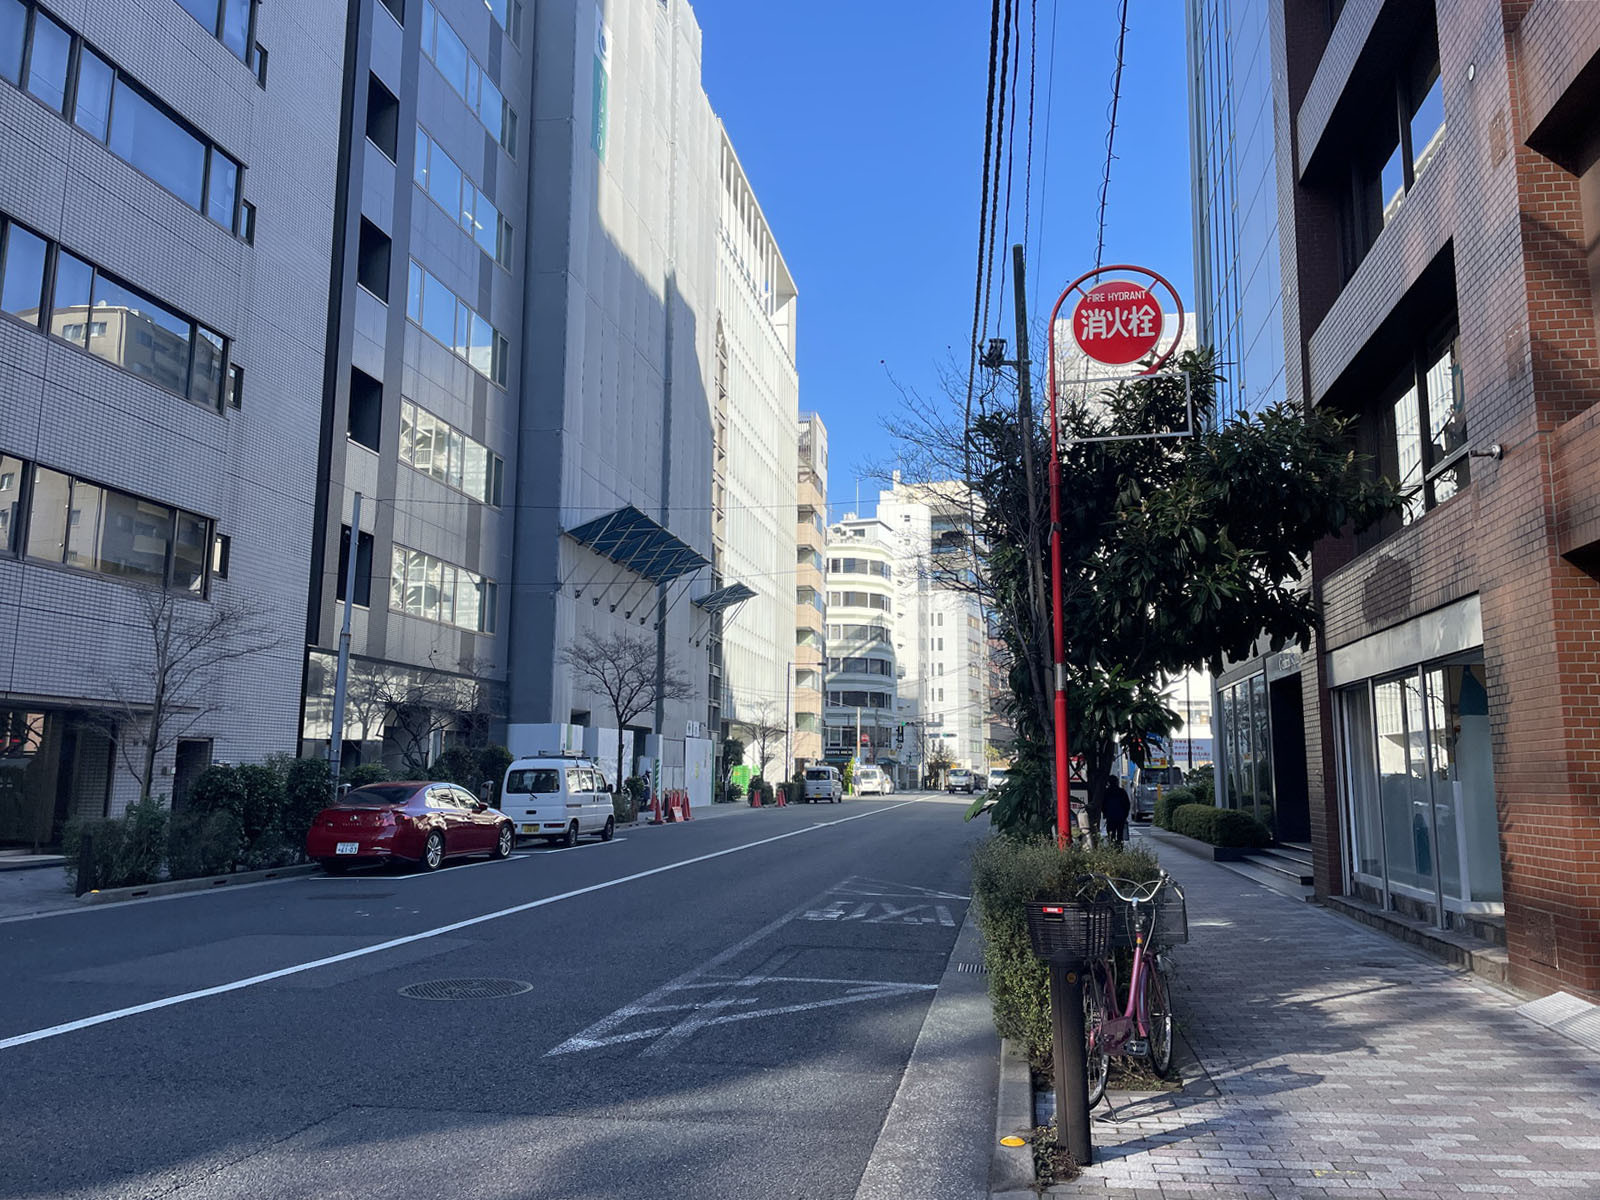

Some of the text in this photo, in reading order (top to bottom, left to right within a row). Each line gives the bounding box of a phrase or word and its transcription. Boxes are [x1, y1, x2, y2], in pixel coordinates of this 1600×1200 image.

[1087, 291, 1146, 303] FIRE HYDRANT
[1081, 305, 1156, 340] 消火栓
